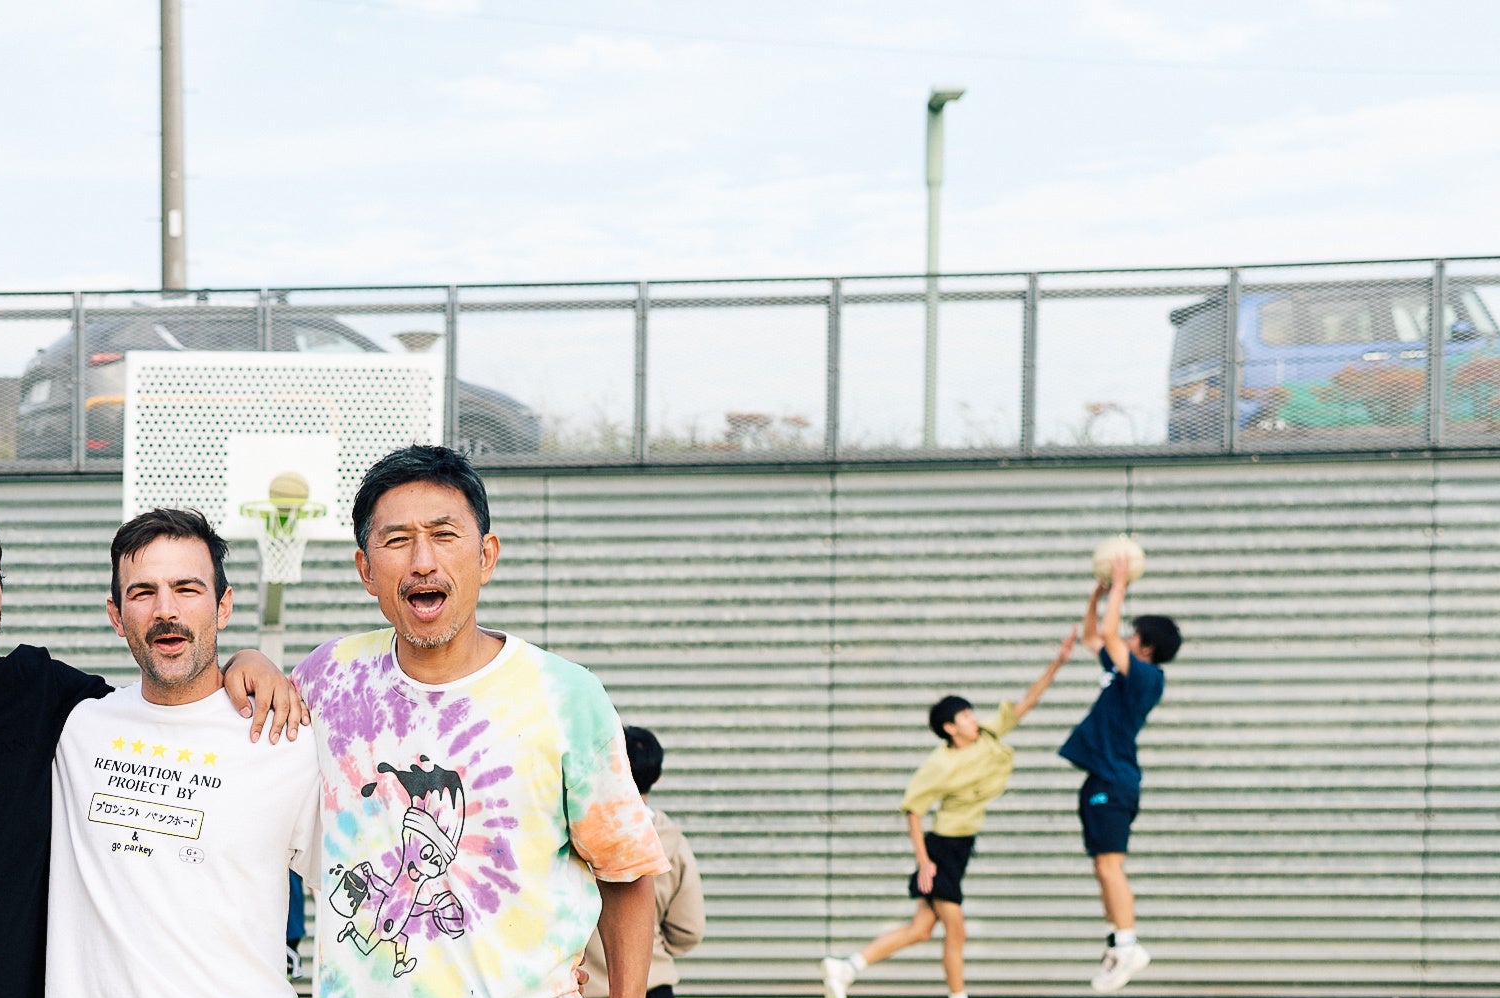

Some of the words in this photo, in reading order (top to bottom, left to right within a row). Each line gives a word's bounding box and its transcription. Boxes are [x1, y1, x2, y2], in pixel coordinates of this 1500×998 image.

[94, 757, 182, 782] RENOVATION
[189, 773, 222, 789] AND
[107, 775, 169, 796] PROJECT
[176, 787, 197, 800] BY
[131, 830, 139, 841] &
[111, 842, 122, 852] go
[124, 843, 154, 857] parkey
